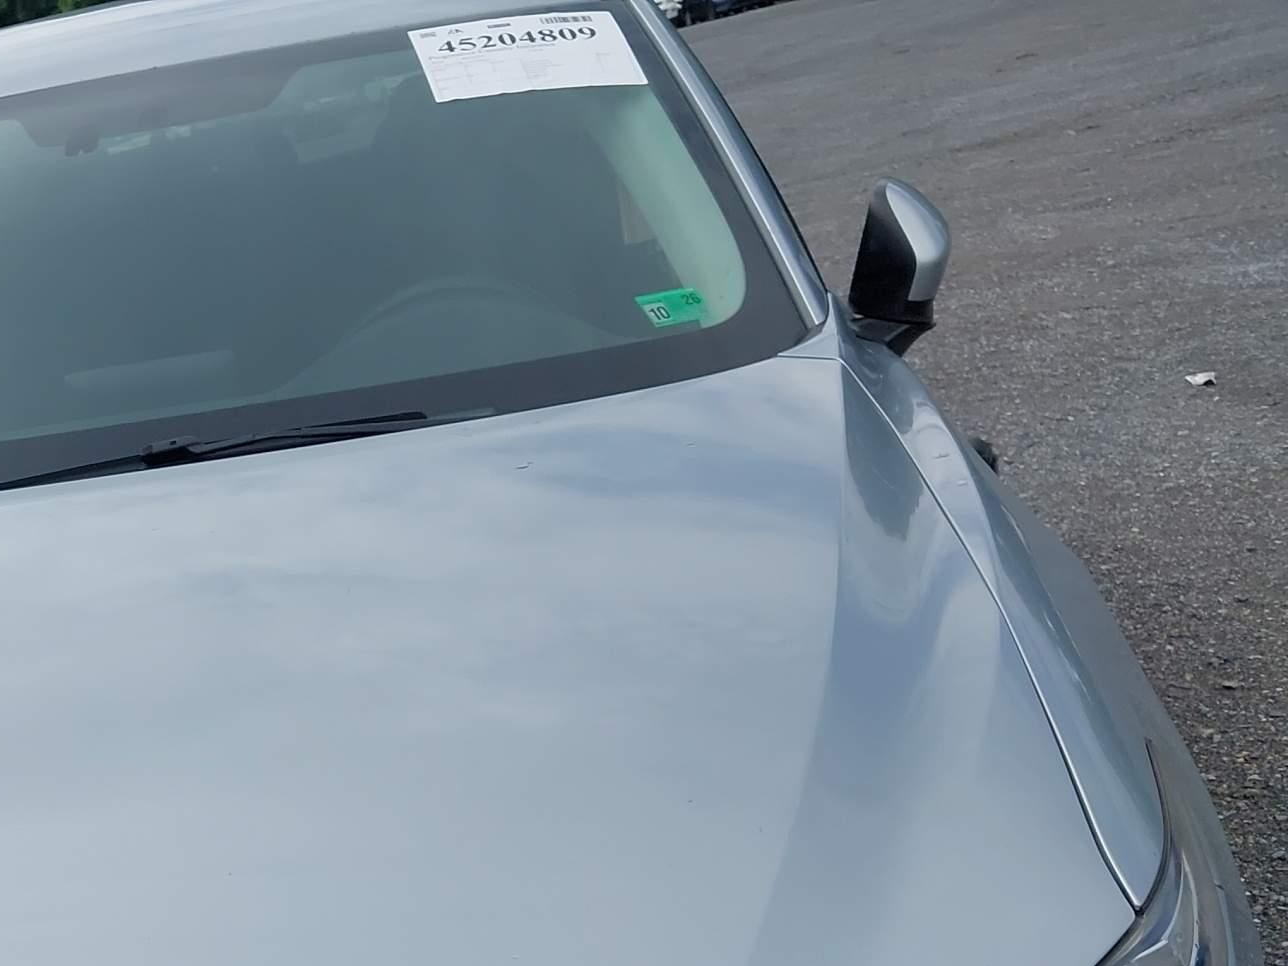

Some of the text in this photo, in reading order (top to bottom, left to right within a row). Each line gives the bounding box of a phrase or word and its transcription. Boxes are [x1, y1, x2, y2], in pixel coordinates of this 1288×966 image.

[438, 26, 597, 53] 45204809
[681, 293, 702, 305] 26
[649, 306, 671, 320] 10
